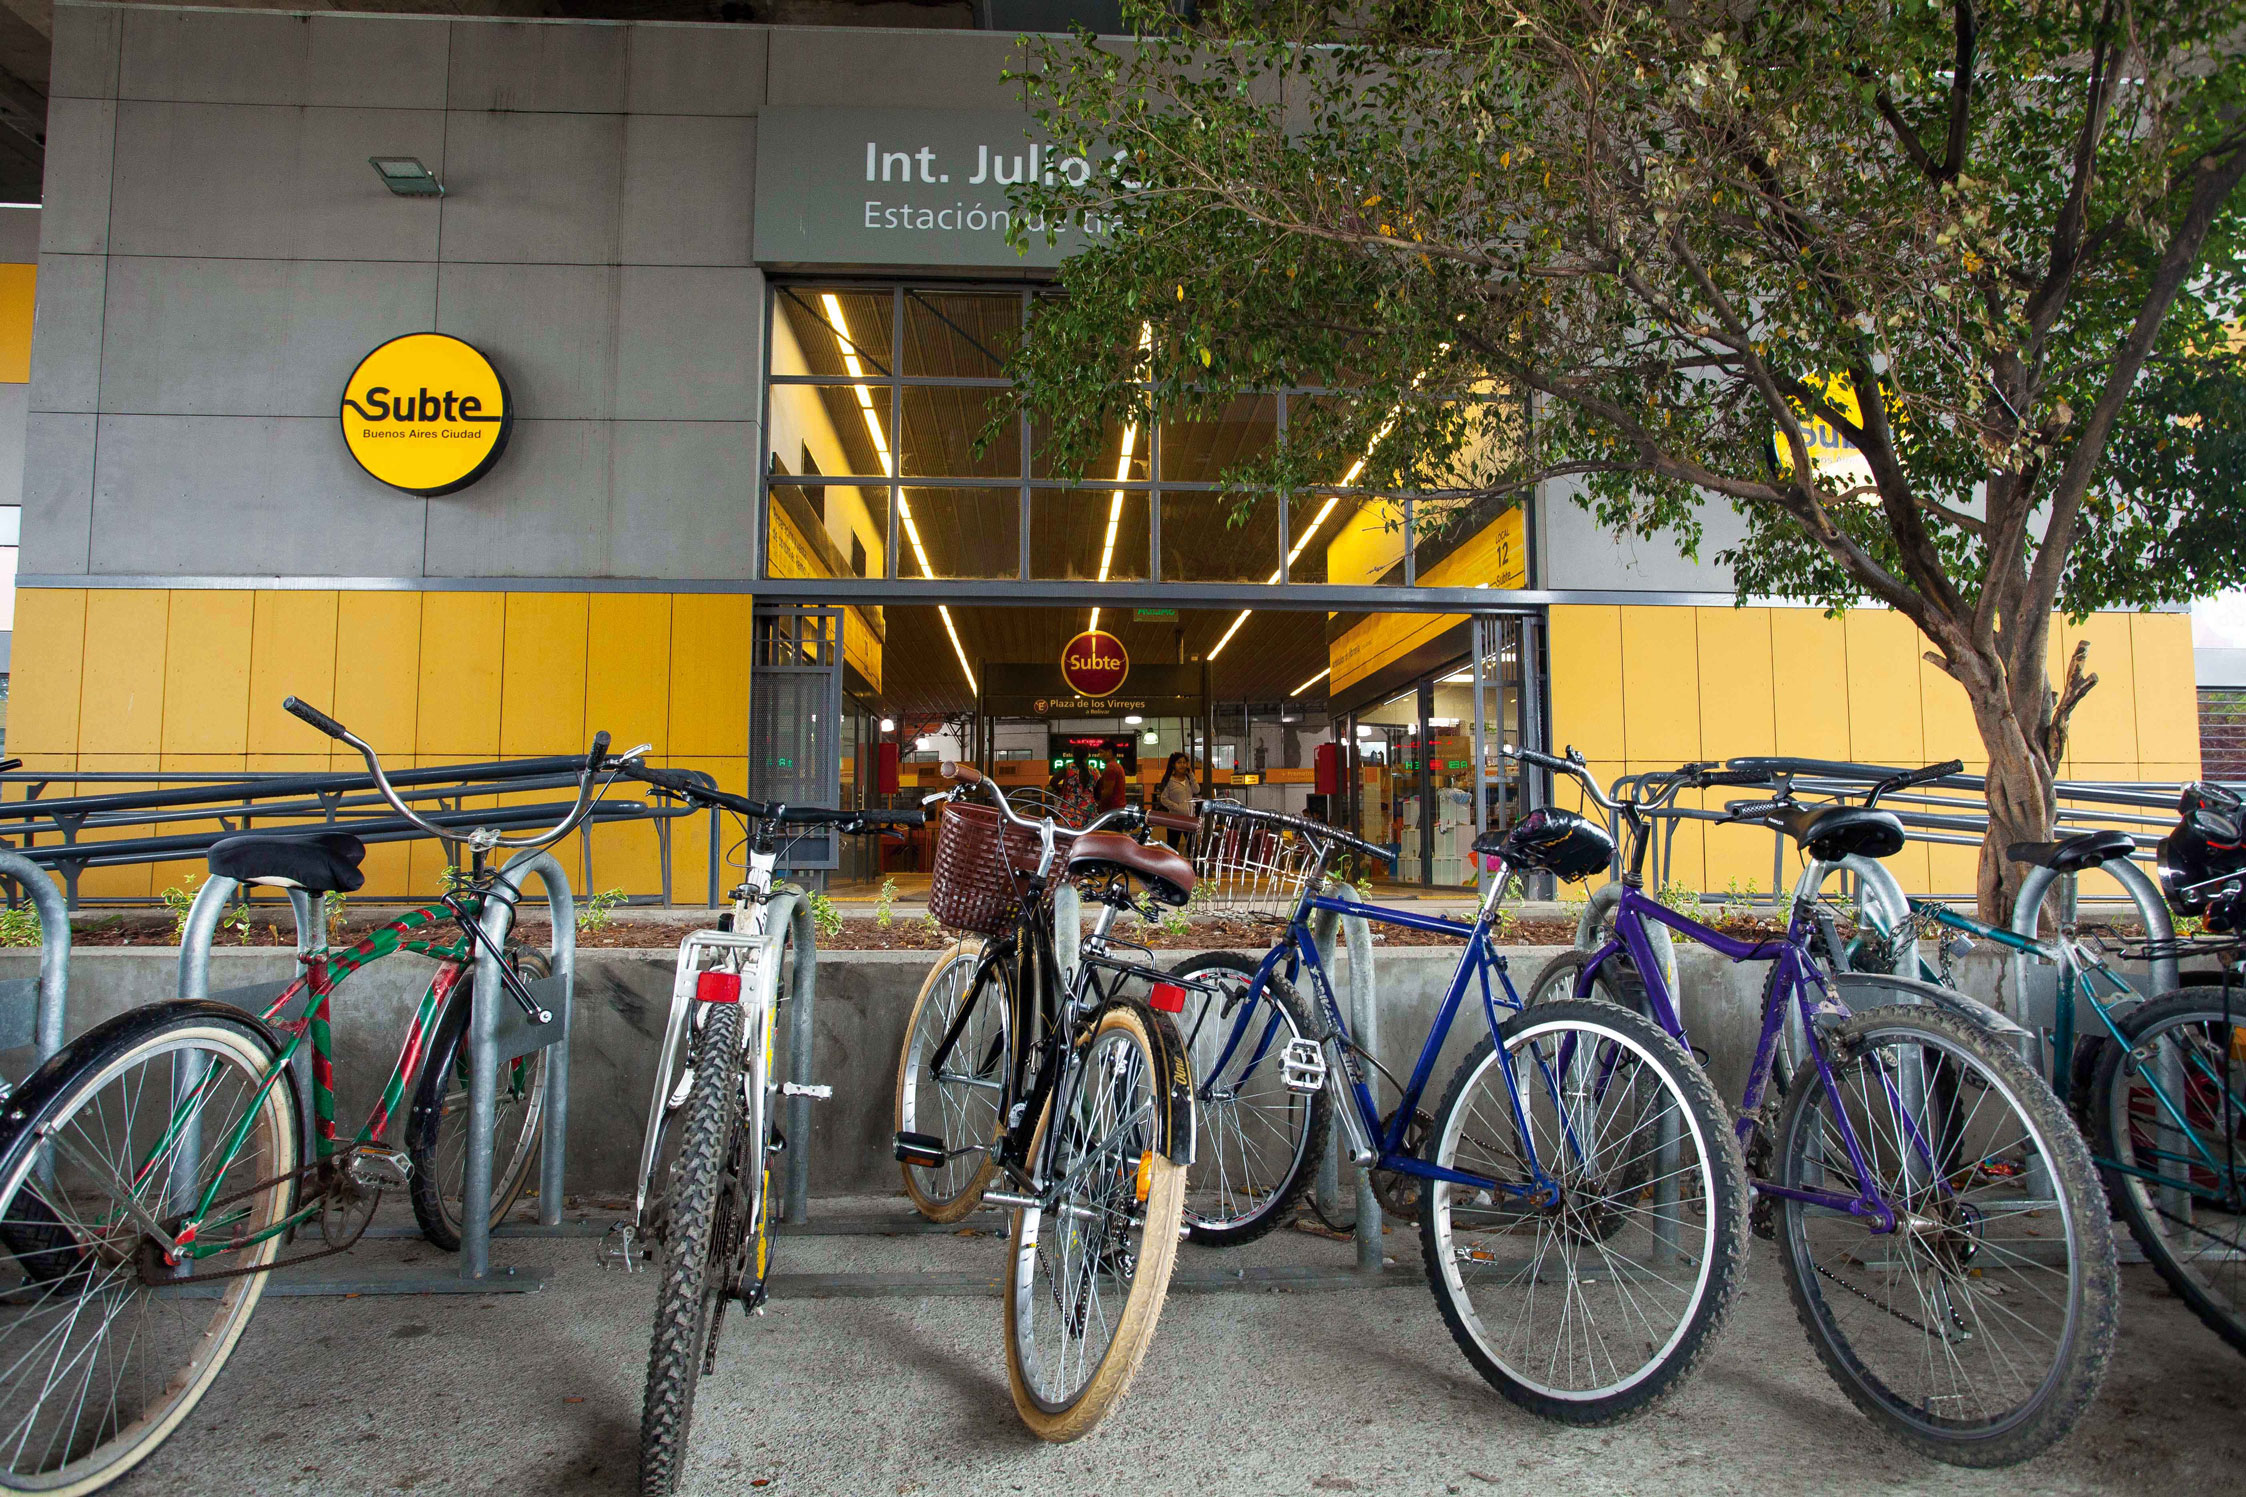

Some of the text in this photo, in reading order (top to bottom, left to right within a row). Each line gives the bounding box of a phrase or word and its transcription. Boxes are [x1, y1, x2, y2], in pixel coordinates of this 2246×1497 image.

[866, 142, 949, 184] Int.
[969, 142, 1091, 187] Julio
[865, 200, 1010, 231] Estación
[362, 386, 484, 422] Subte
[362, 429, 482, 439] Buenos Aires Ciudad
[1495, 528, 1510, 544] LOCAL
[1497, 542, 1508, 568] 12
[1070, 654, 1121, 671] Subte
[1050, 699, 1146, 711] Plaza de los Virreyes
